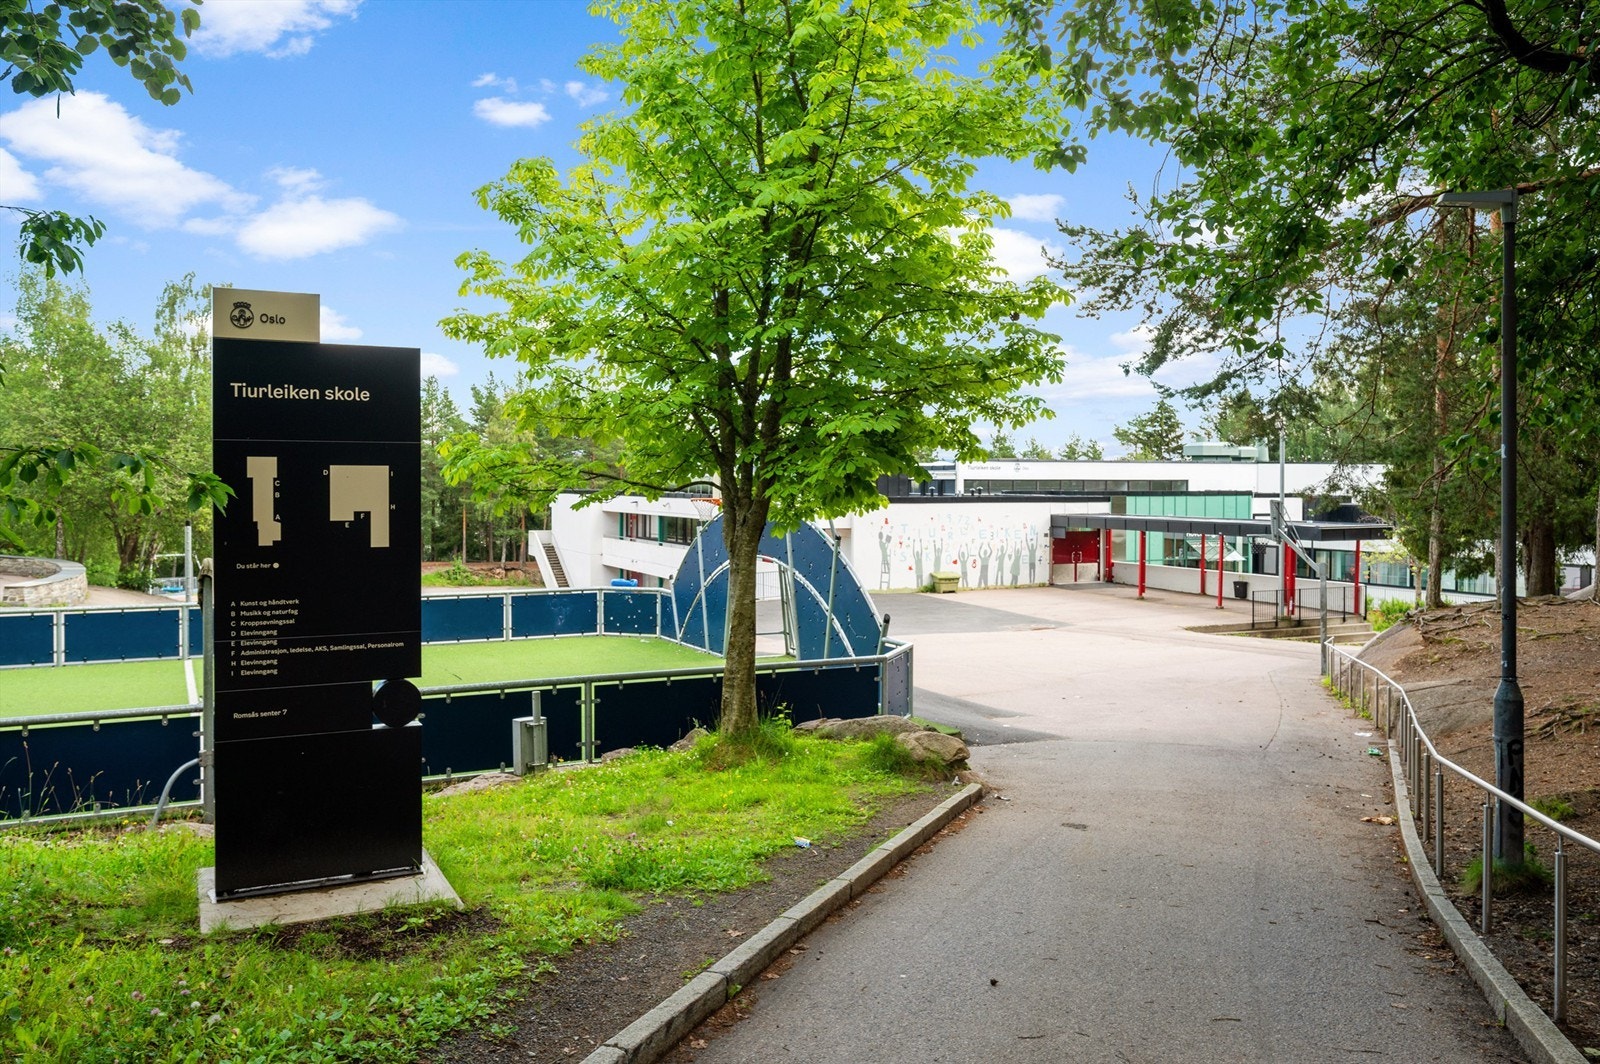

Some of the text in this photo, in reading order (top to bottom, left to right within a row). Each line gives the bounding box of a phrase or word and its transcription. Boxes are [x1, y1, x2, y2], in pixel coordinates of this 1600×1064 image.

[259, 312, 286, 325] Oslo
[230, 382, 370, 402] Tiurleiken skole
[274, 479, 281, 487] C
[274, 491, 281, 499] B
[360, 512, 365, 520] F
[236, 561, 272, 570] Du står her
[271, 608, 299, 616] naturfag
[240, 618, 296, 627] Kroppsøvningssal
[240, 629, 278, 637] Elevinngang
[240, 648, 290, 657] Administrasjon,
[289, 646, 314, 654] ledelse,
[314, 645, 329, 653] AKS,
[329, 643, 368, 652] Samlingssal,
[240, 659, 278, 667] Elevinngang
[233, 708, 288, 720] Romsås senter 7
